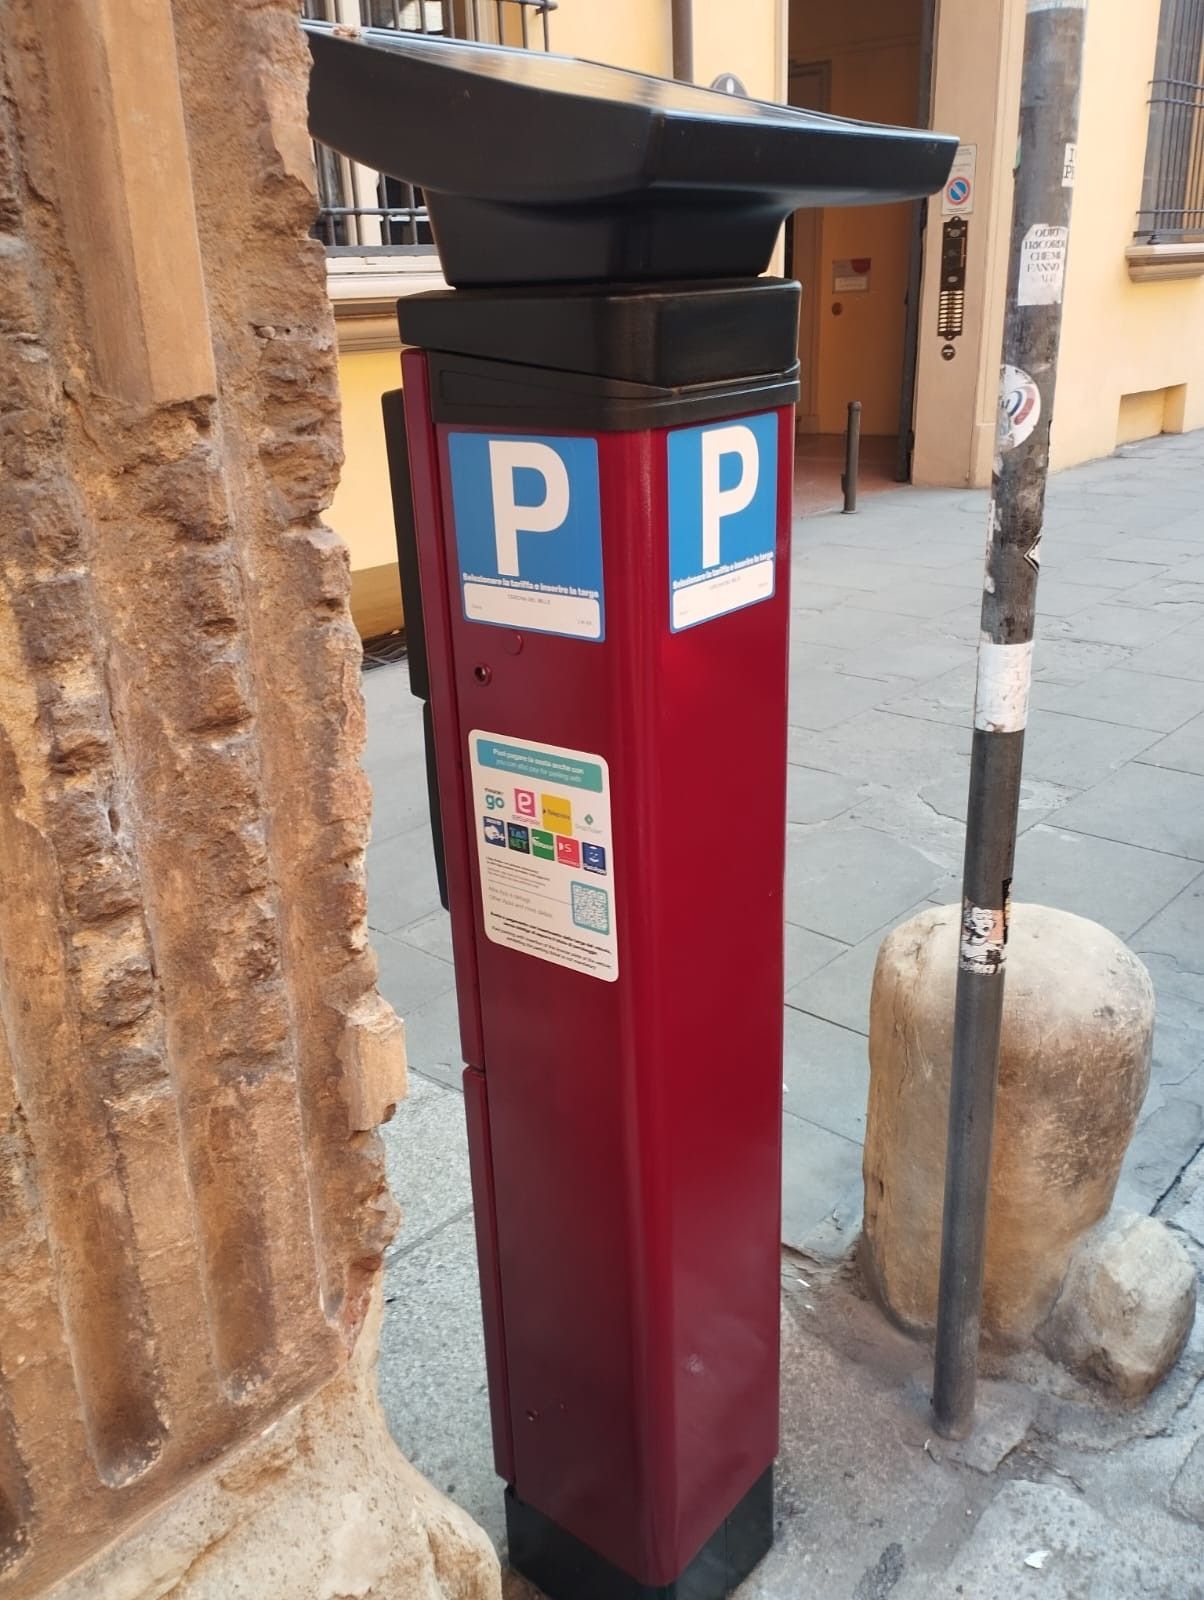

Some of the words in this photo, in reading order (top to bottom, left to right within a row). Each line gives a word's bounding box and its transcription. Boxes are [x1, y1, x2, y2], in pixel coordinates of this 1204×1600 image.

[488, 440, 570, 577] P
[701, 424, 760, 569] P
[485, 794, 504, 810] go
